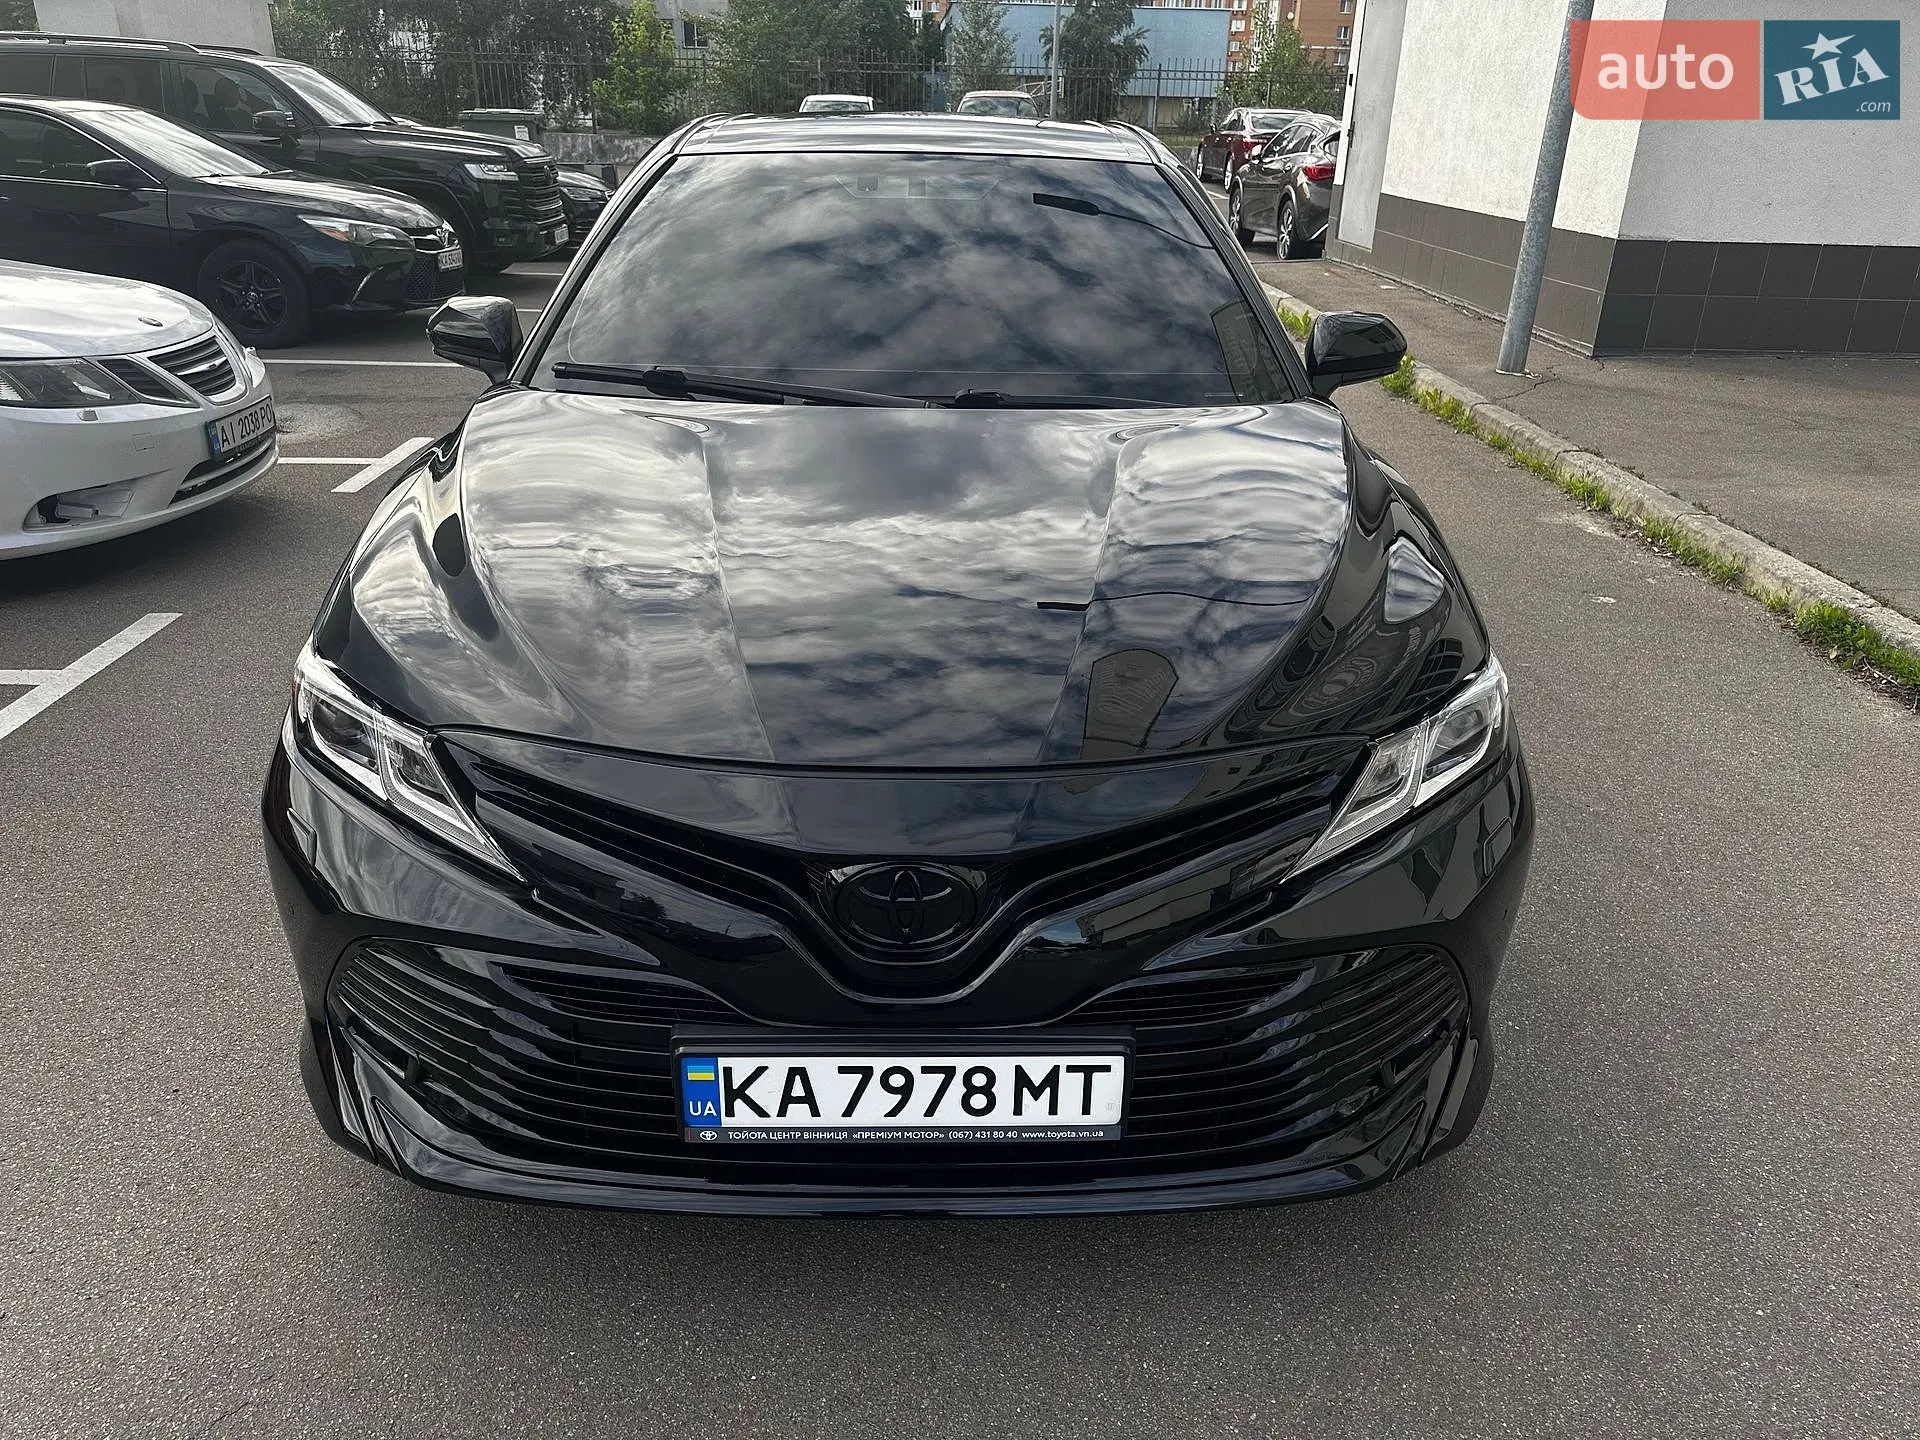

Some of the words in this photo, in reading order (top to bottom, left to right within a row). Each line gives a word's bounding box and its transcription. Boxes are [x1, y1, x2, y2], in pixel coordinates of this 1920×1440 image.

[221, 421, 236, 449] AI
[238, 410, 261, 440] 2038
[260, 403, 273, 428] PO
[722, 1065, 822, 1119] KA
[837, 1065, 997, 1118] 7978
[1012, 1064, 1112, 1117] MT
[689, 1101, 718, 1117] UA
[727, 1130, 768, 1140] ТОЙОТА
[769, 1131, 802, 1141] ЦЕНТР
[803, 1130, 848, 1140] ВІННИЦЯ
[903, 1131, 945, 1139] МОТОР»
[948, 1130, 973, 1140] (067)
[974, 1130, 991, 1139] 431
[992, 1130, 1005, 1139] 80
[1006, 1130, 1018, 1139] 40
[1021, 1129, 1105, 1140] www.toyota.vn.ua
